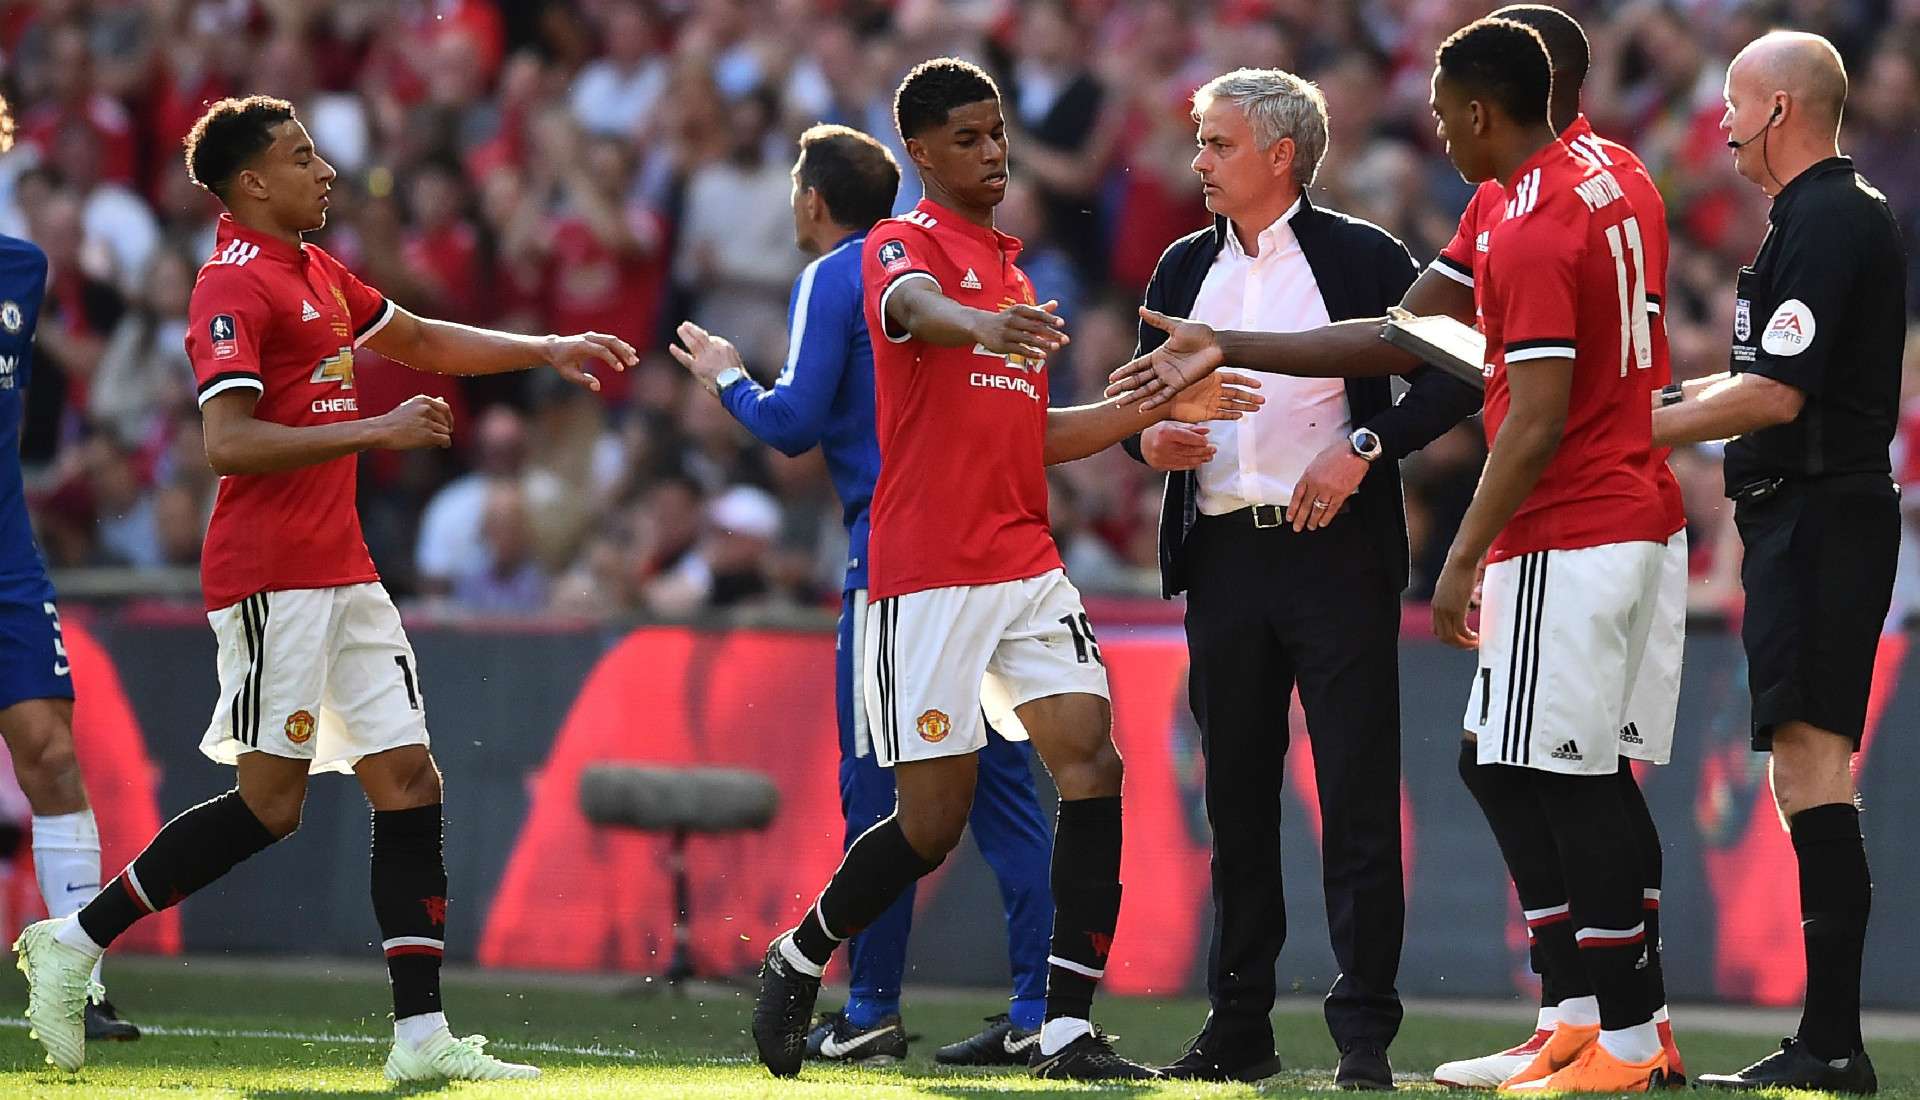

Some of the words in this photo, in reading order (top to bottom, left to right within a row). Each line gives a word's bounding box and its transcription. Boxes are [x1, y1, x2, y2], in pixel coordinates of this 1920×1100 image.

[1604, 216, 1652, 378] 11
[1772, 312, 1802, 336] EA
[1619, 734, 1645, 746] didas
[1550, 751, 1584, 761] adidas
